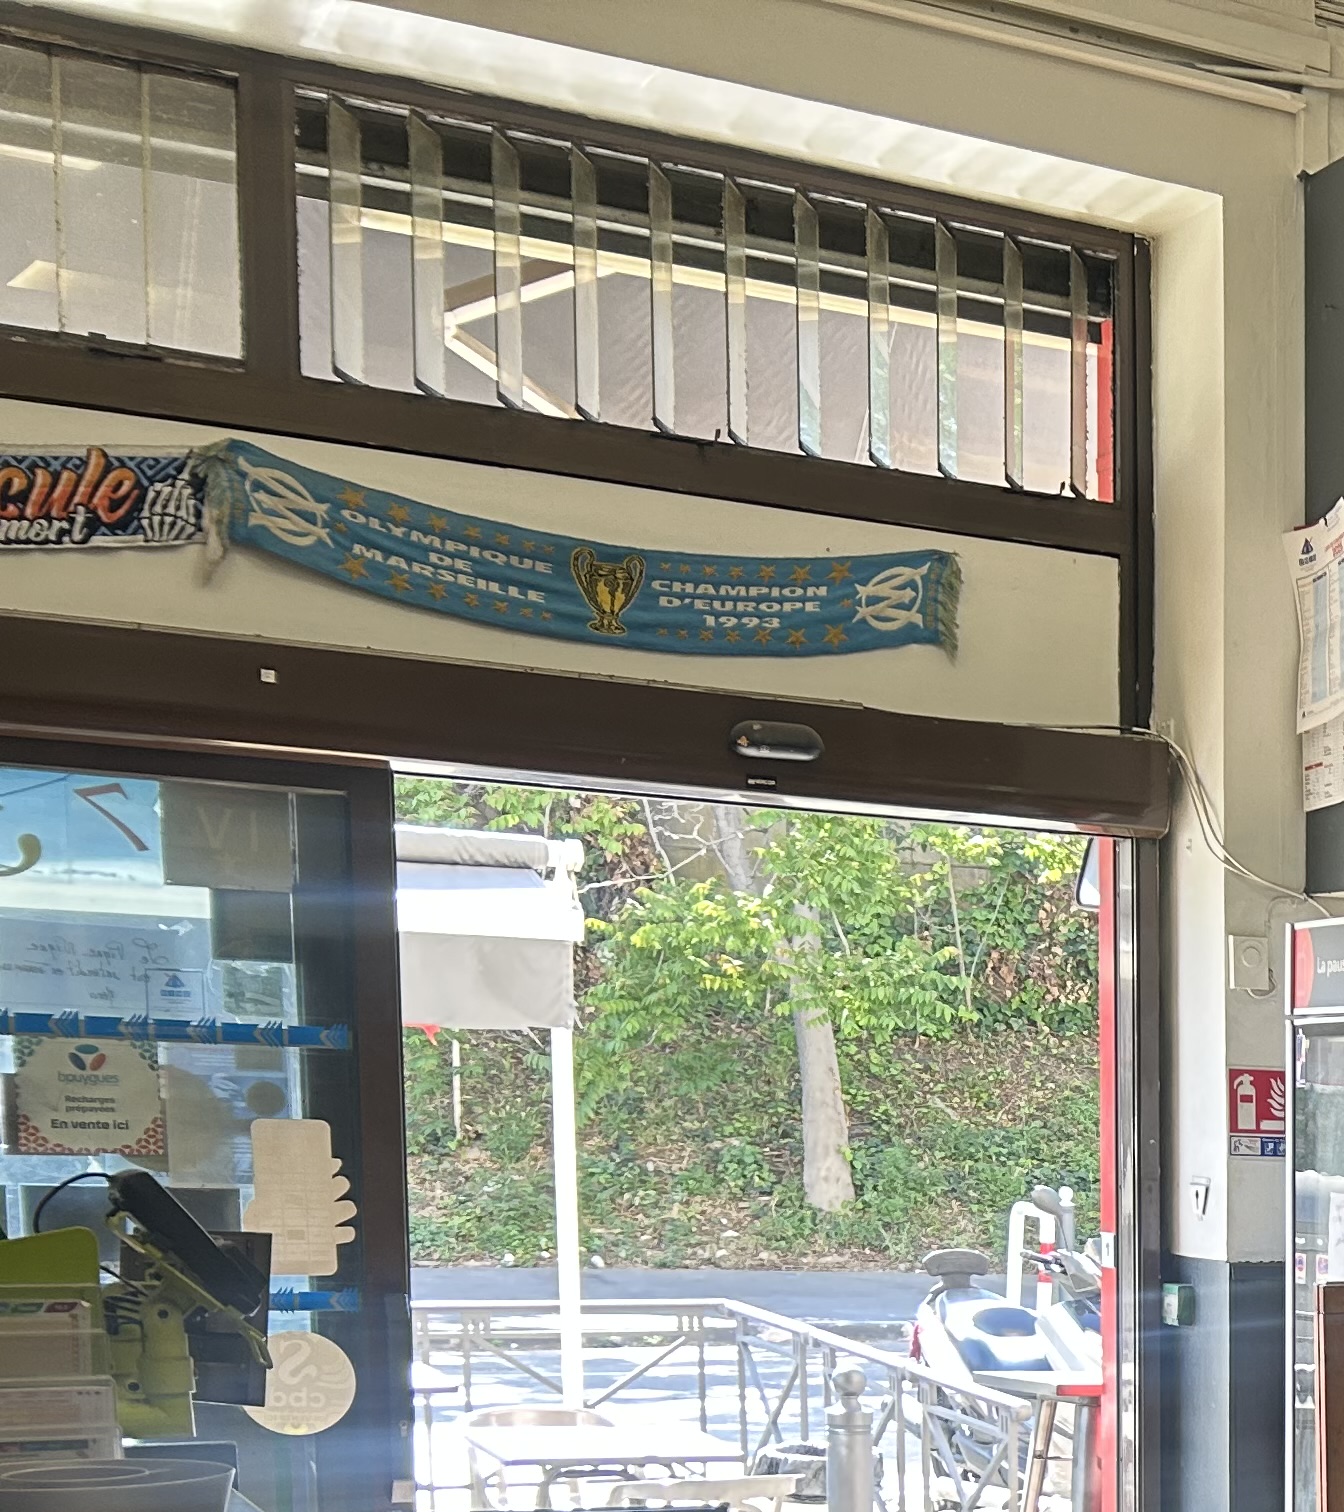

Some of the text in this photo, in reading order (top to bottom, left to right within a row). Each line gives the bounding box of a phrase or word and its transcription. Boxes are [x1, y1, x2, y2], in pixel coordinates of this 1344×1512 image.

[340, 509, 554, 574] OLYMPIQUE
[428, 552, 473, 573] DE
[351, 543, 546, 604] MARSEILLE
[651, 579, 828, 598] CHAMPION
[658, 596, 821, 613] D'EUROPE
[701, 614, 782, 629] 1993
[1316, 956, 1326, 974] La
[51, 1119, 130, 1130] En vente ici
